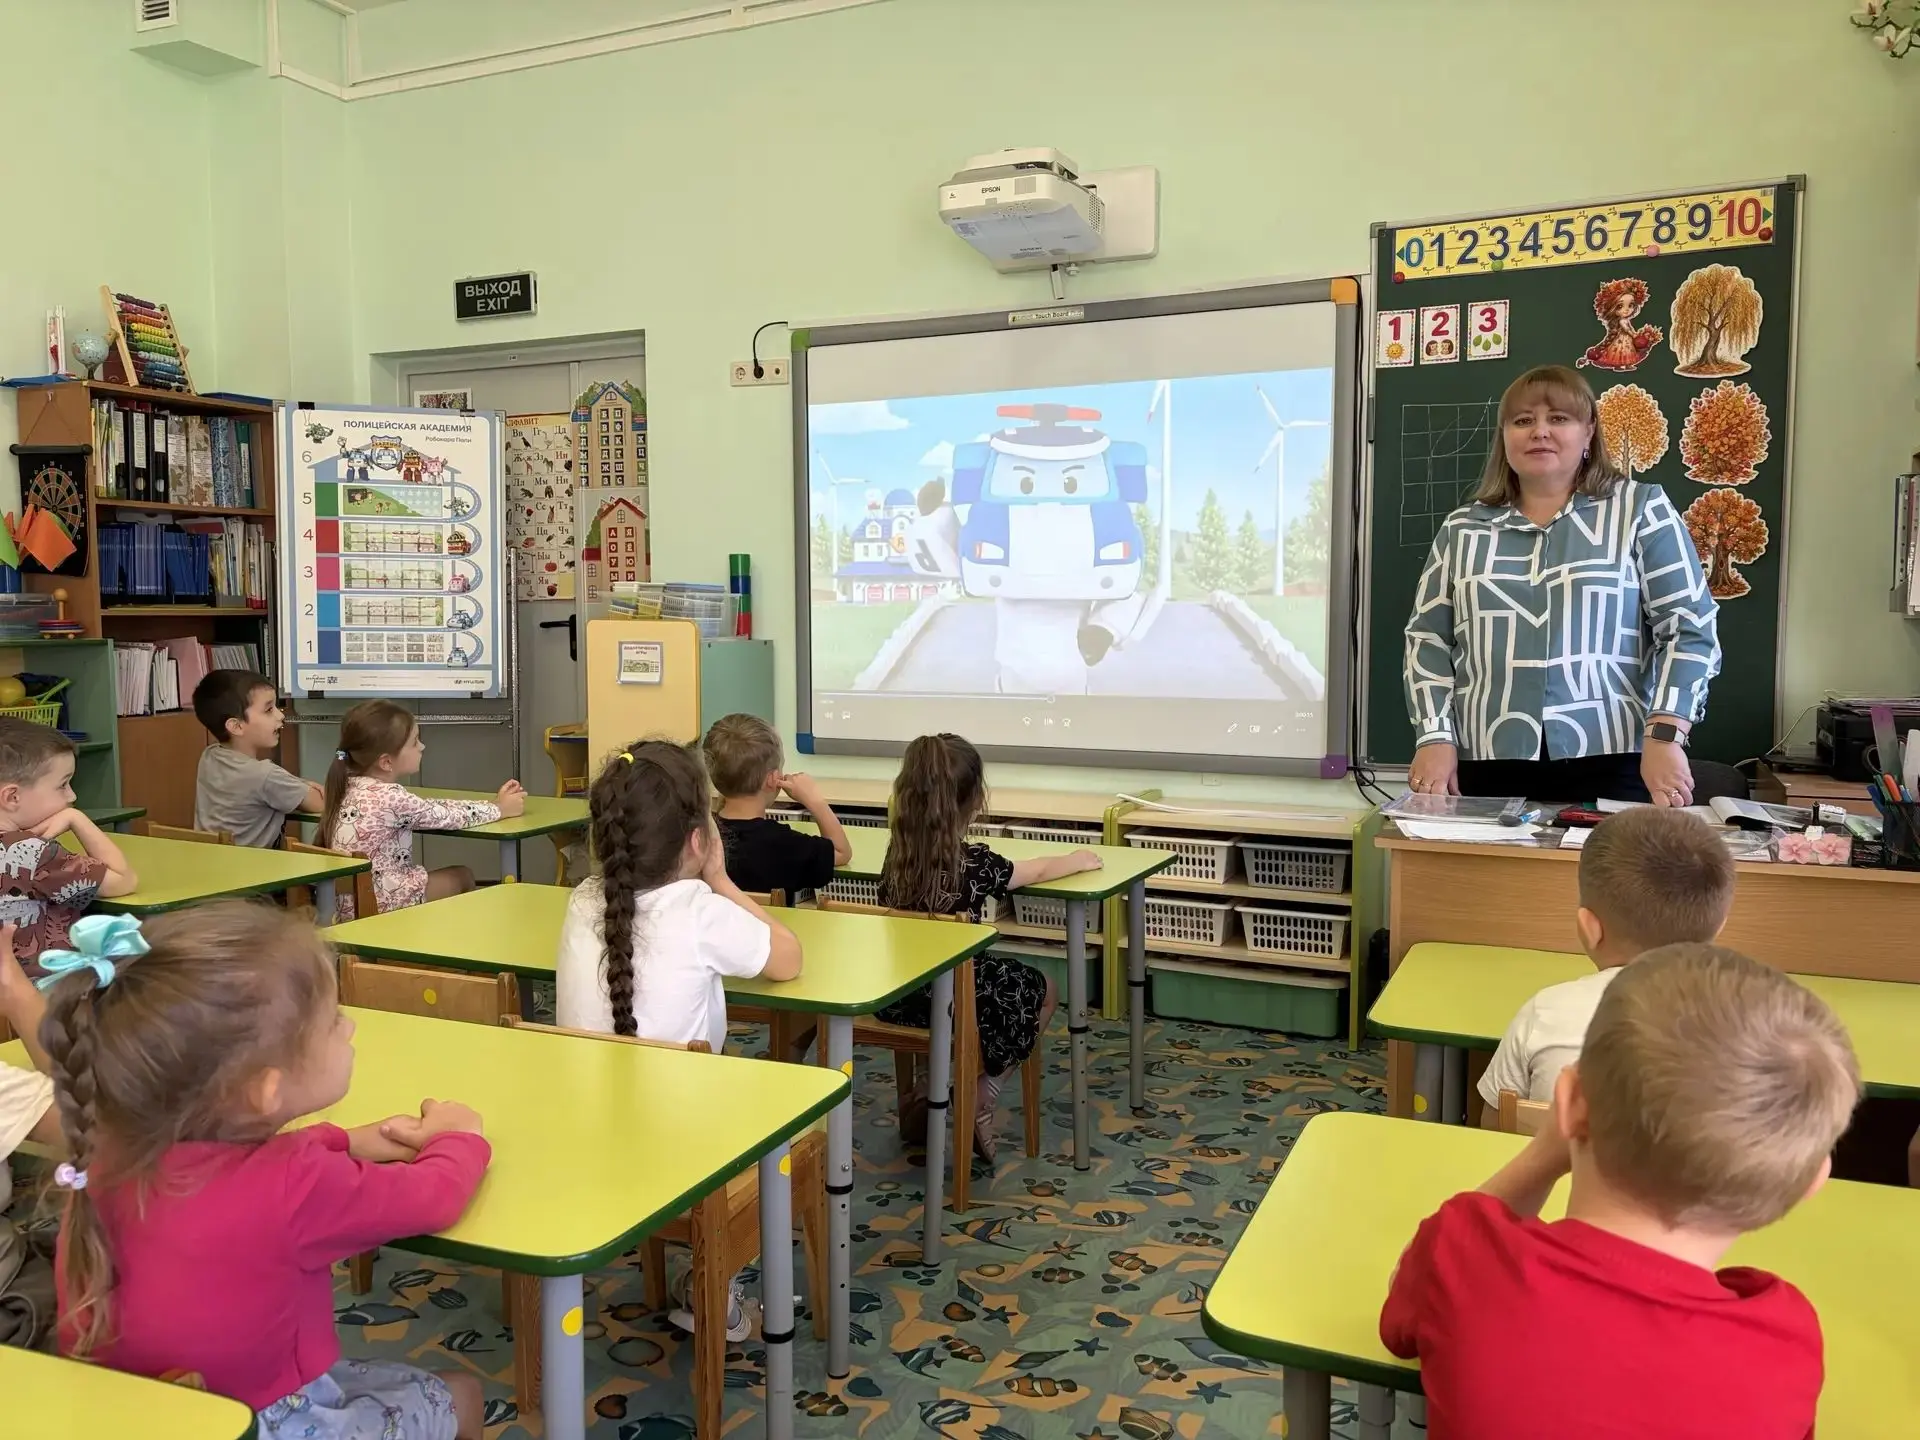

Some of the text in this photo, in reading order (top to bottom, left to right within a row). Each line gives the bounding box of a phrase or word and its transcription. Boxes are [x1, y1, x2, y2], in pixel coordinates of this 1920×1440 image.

[1406, 197, 1762, 267] 0 1 2 3 4 5 6 7 8 9 10
[465, 280, 521, 297] ВЫХОД
[477, 296, 510, 312] EXIT
[1431, 311, 1450, 336] 2
[1478, 307, 1497, 332] 3
[1389, 316, 1401, 341] 1
[344, 420, 471, 432] ПОЛИЦЕЙСКАЯ АКАДЕМИЯ
[302, 451, 312, 463] 6
[302, 493, 312, 504] 5
[303, 529, 314, 540] 4
[304, 566, 313, 578] 3
[305, 604, 313, 616] 2
[307, 641, 312, 652] 1
